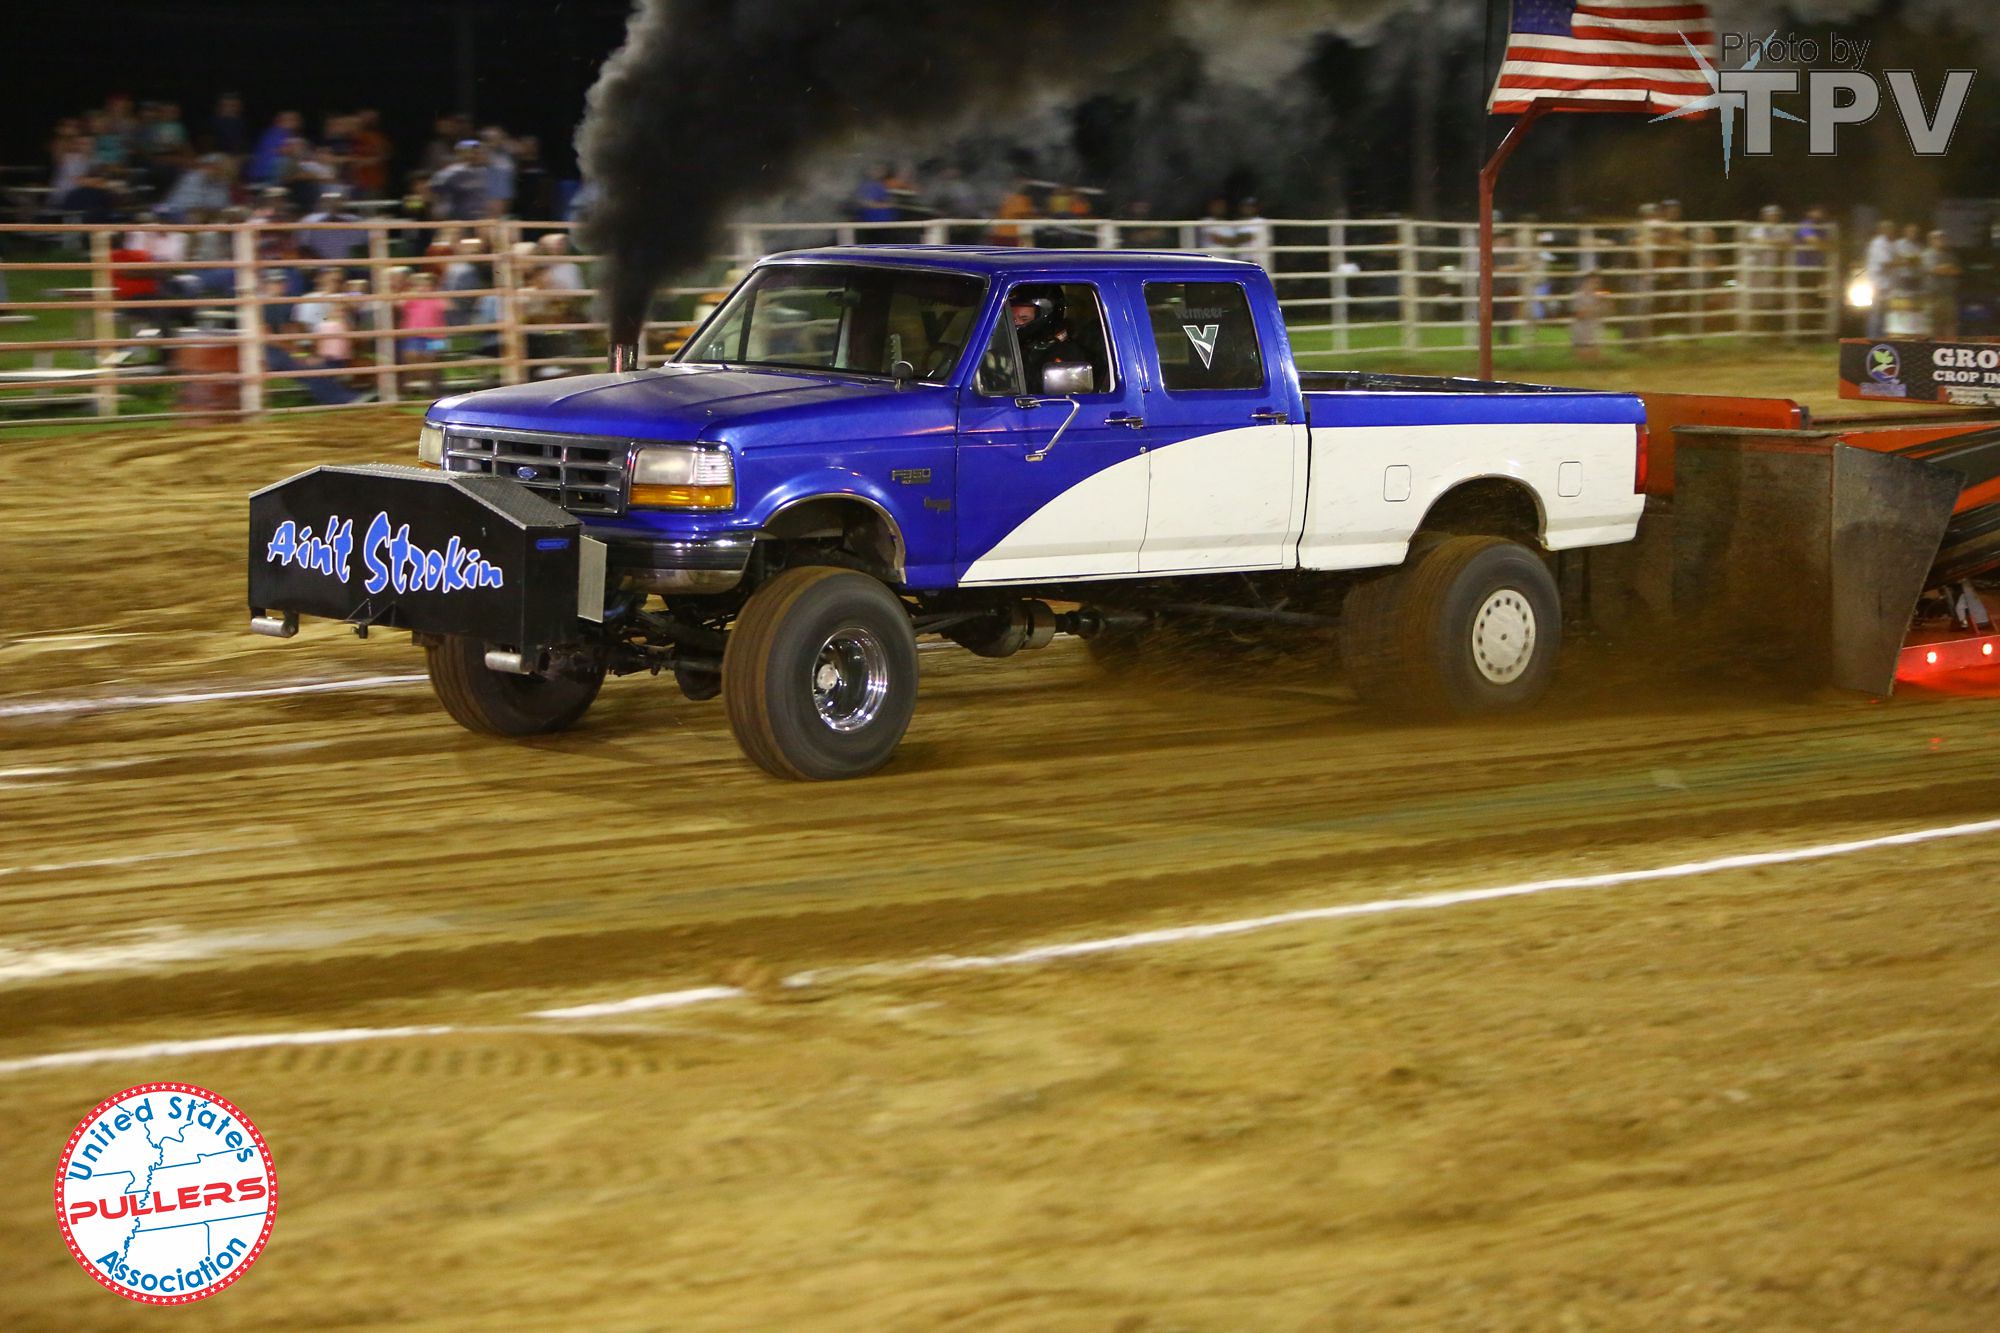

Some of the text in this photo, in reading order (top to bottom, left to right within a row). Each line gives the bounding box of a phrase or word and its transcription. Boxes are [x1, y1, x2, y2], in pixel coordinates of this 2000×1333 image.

[1932, 348, 2000, 368] GRO
[1932, 370, 1980, 382] CROP
[267, 511, 504, 594] Ain't Strokin
